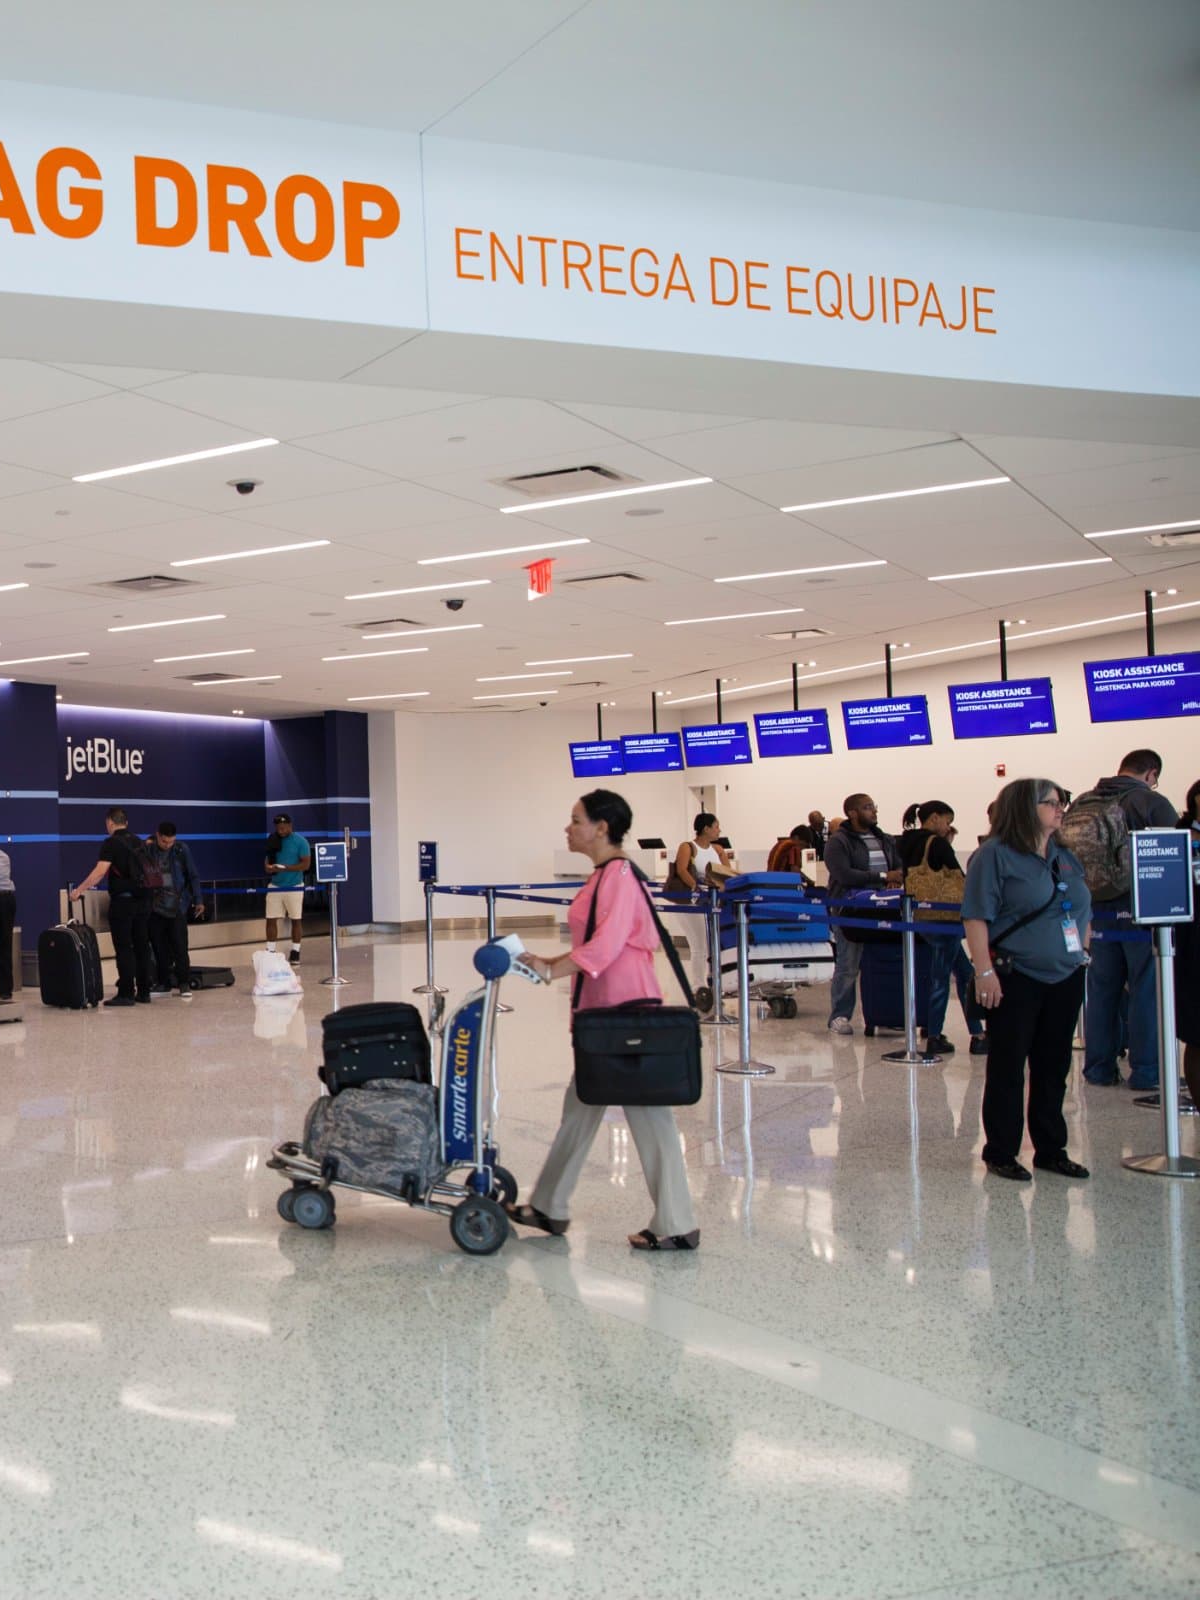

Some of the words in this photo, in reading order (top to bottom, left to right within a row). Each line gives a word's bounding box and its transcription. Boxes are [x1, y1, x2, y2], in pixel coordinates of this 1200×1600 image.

[134, 155, 400, 268] DROP
[455, 227, 695, 302] ENTREGA
[710, 257, 770, 310] DE
[786, 266, 996, 334] EQUIPAJE
[1093, 669, 1123, 679] KIOSK
[1123, 662, 1185, 676] ASSISTANCE
[1095, 683, 1131, 692] ASISTENCIA
[1132, 681, 1150, 689] PARA
[955, 692, 980, 700] KIOSK
[981, 687, 1032, 699] ASSISTANCE
[848, 707, 868, 715] KIOSK
[869, 703, 911, 713] ASSISTANCE
[777, 716, 814, 725] ASSISTANCE
[703, 729, 736, 737] ASSISTANCE
[65, 736, 144, 781] jetBlue
[1138, 839, 1158, 847] KIOSK
[1138, 847, 1179, 856] ASSISTANCE
[450, 1028, 471, 1143] smartecarte
